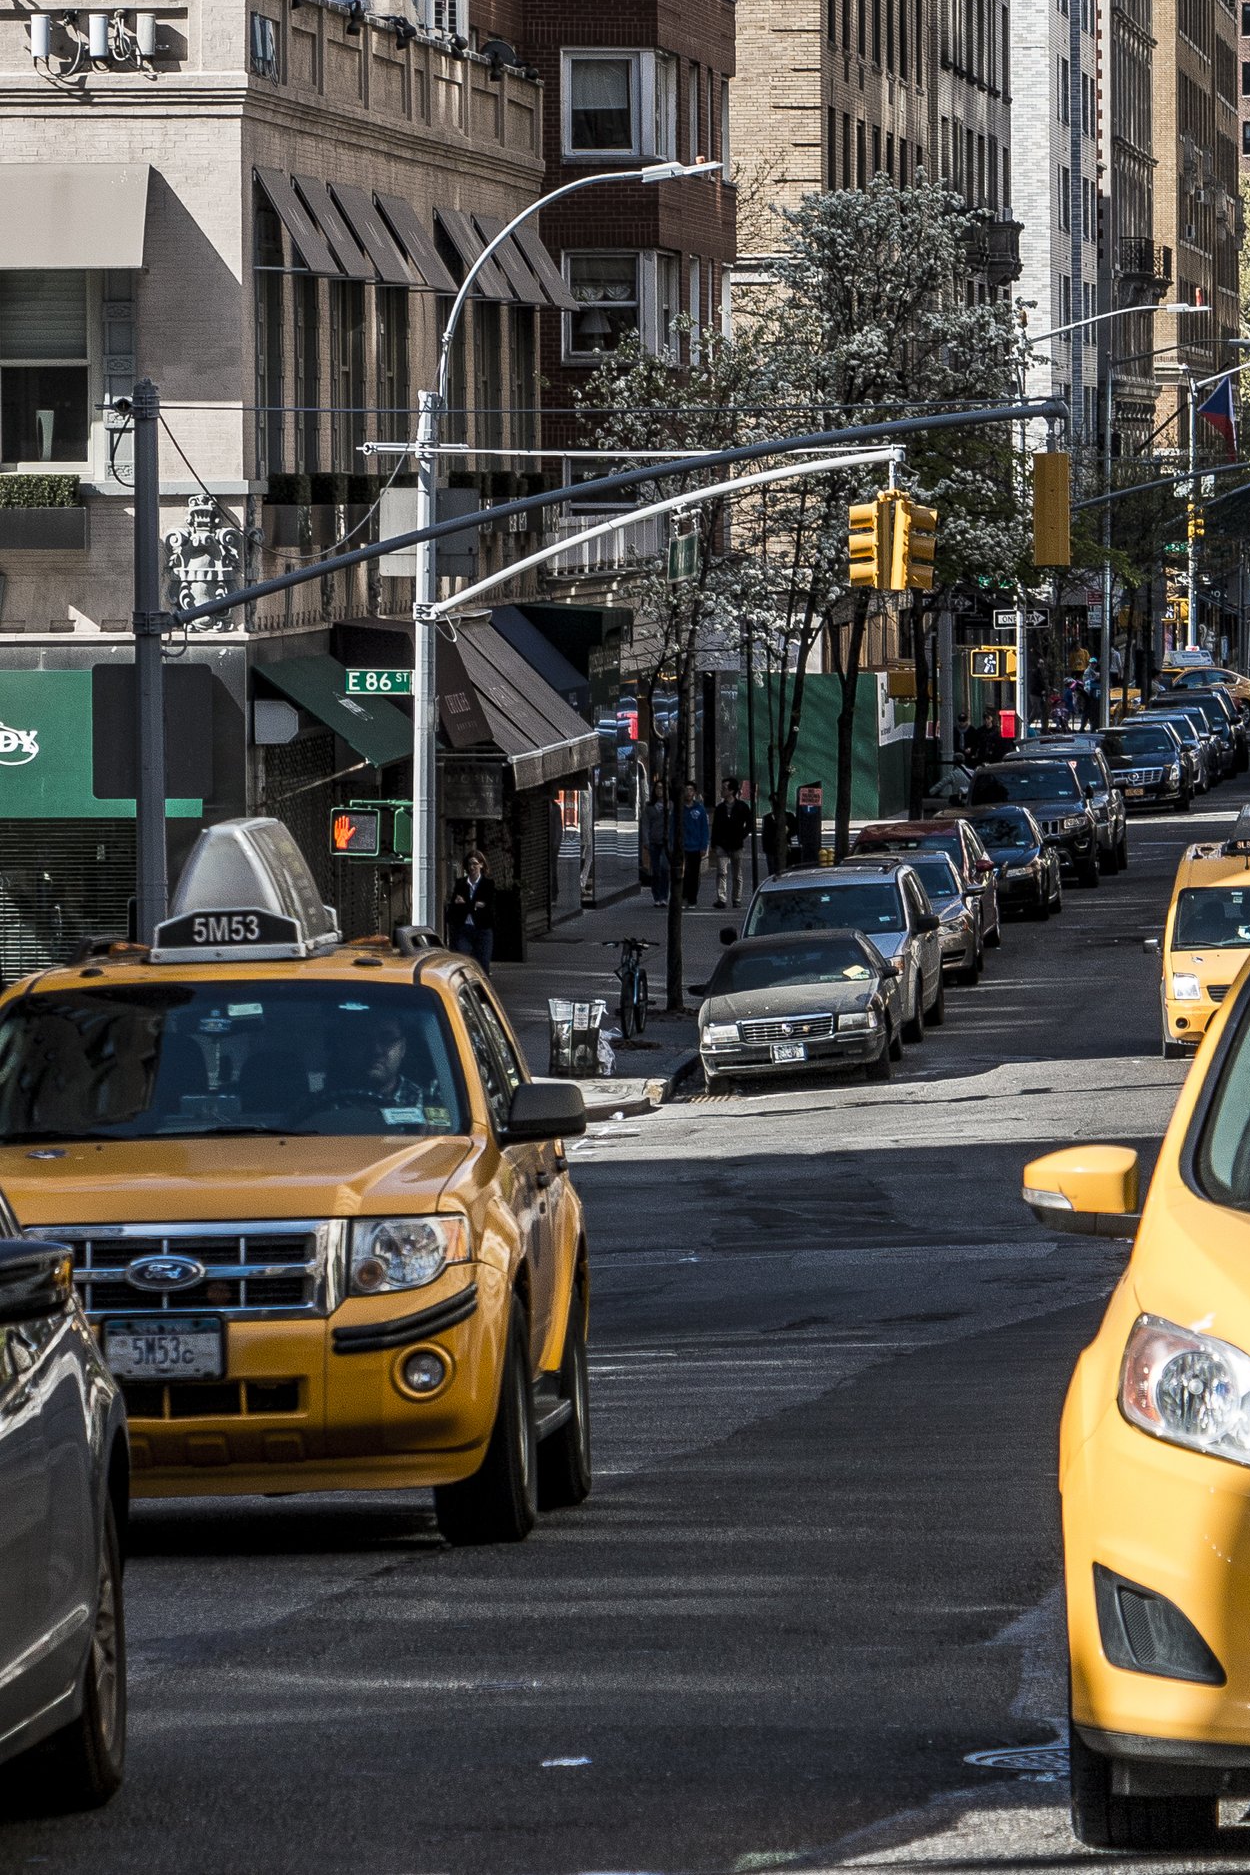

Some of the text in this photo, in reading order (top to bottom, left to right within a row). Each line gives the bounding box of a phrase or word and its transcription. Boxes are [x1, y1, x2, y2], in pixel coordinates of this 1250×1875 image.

[1002, 615, 1017, 623] ONE
[348, 672, 409, 691] E 86 ST
[192, 915, 260, 943] 5M53
